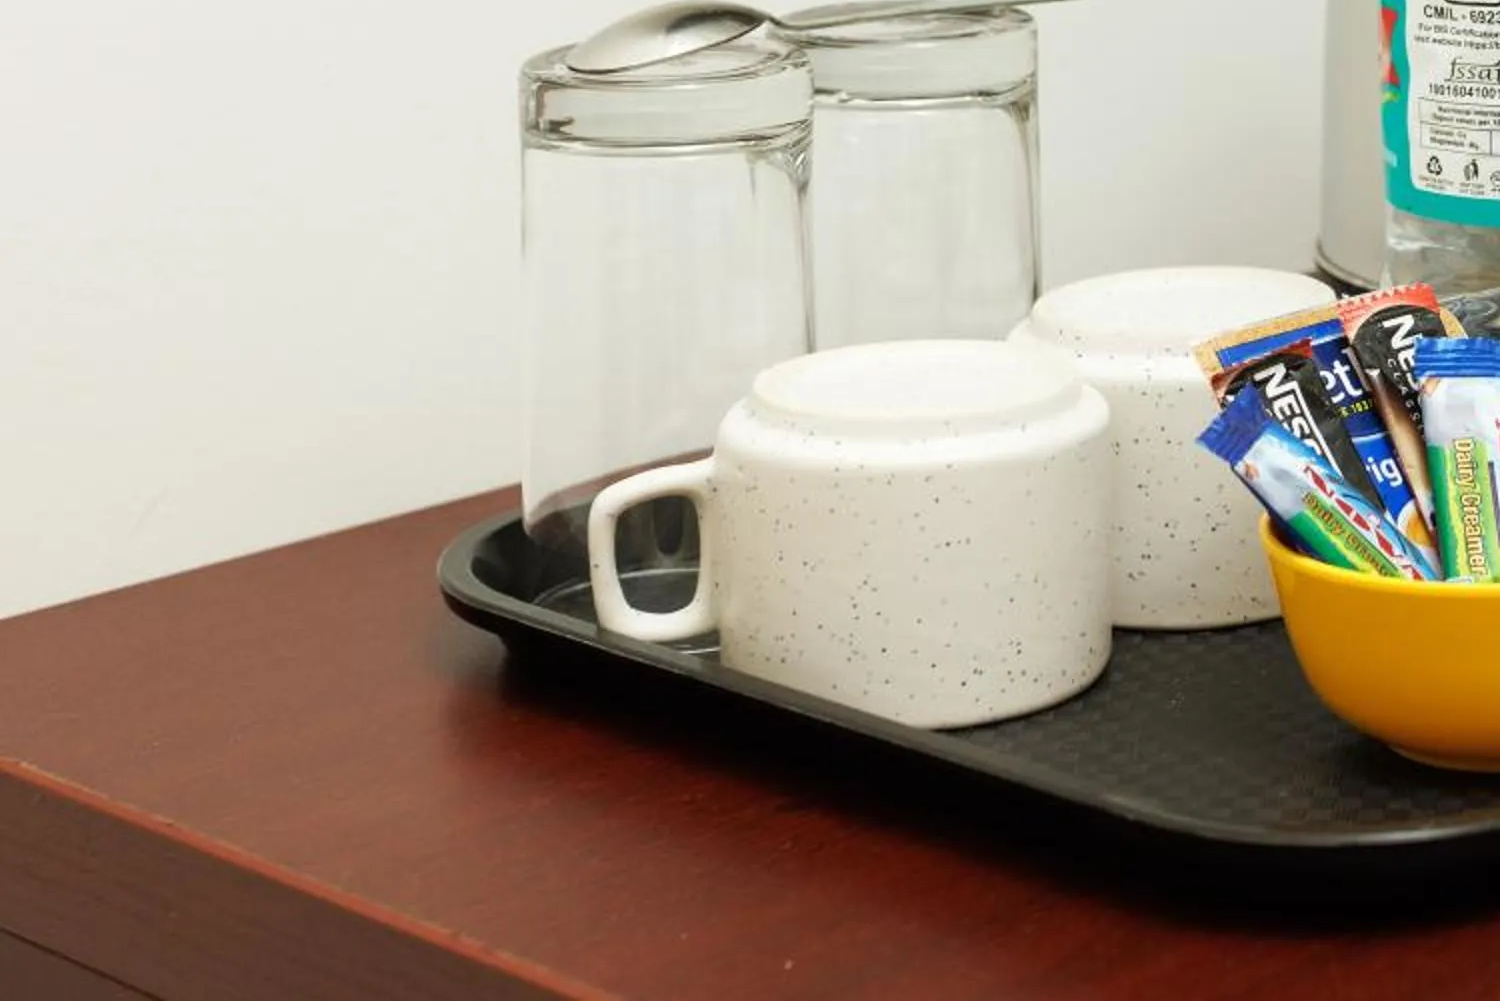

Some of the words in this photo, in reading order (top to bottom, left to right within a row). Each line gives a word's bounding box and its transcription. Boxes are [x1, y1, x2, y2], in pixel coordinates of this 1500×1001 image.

[1423, 4, 1458, 20] CM/L
[1252, 362, 1324, 456] NES
[1453, 436, 1477, 489] Dairy
[1459, 491, 1489, 577] Creamer
